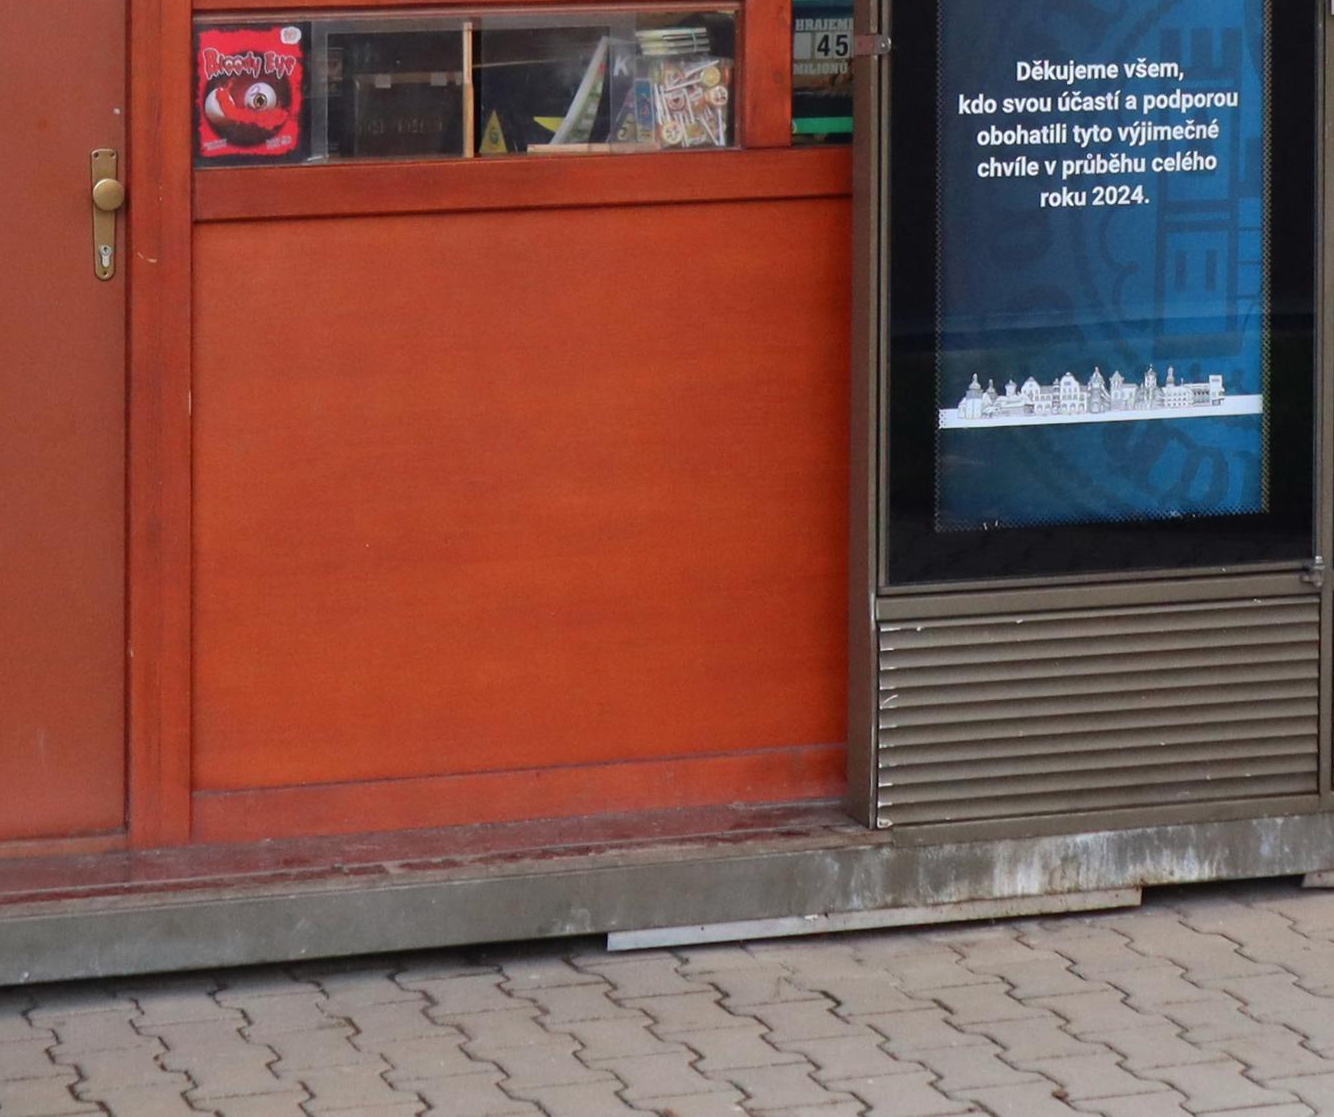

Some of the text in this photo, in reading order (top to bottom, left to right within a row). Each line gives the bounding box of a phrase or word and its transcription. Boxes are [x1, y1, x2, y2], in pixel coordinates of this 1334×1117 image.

[816, 34, 849, 57] 45
[1017, 58, 1183, 84] Děkujeme všem,
[959, 89, 1237, 114] kdo svou účastí a podporou
[977, 119, 1219, 147] obohatili tyto výjimečné
[978, 151, 1217, 179] chvíle v průběhu celého
[1041, 185, 1149, 207] roku 2024.
